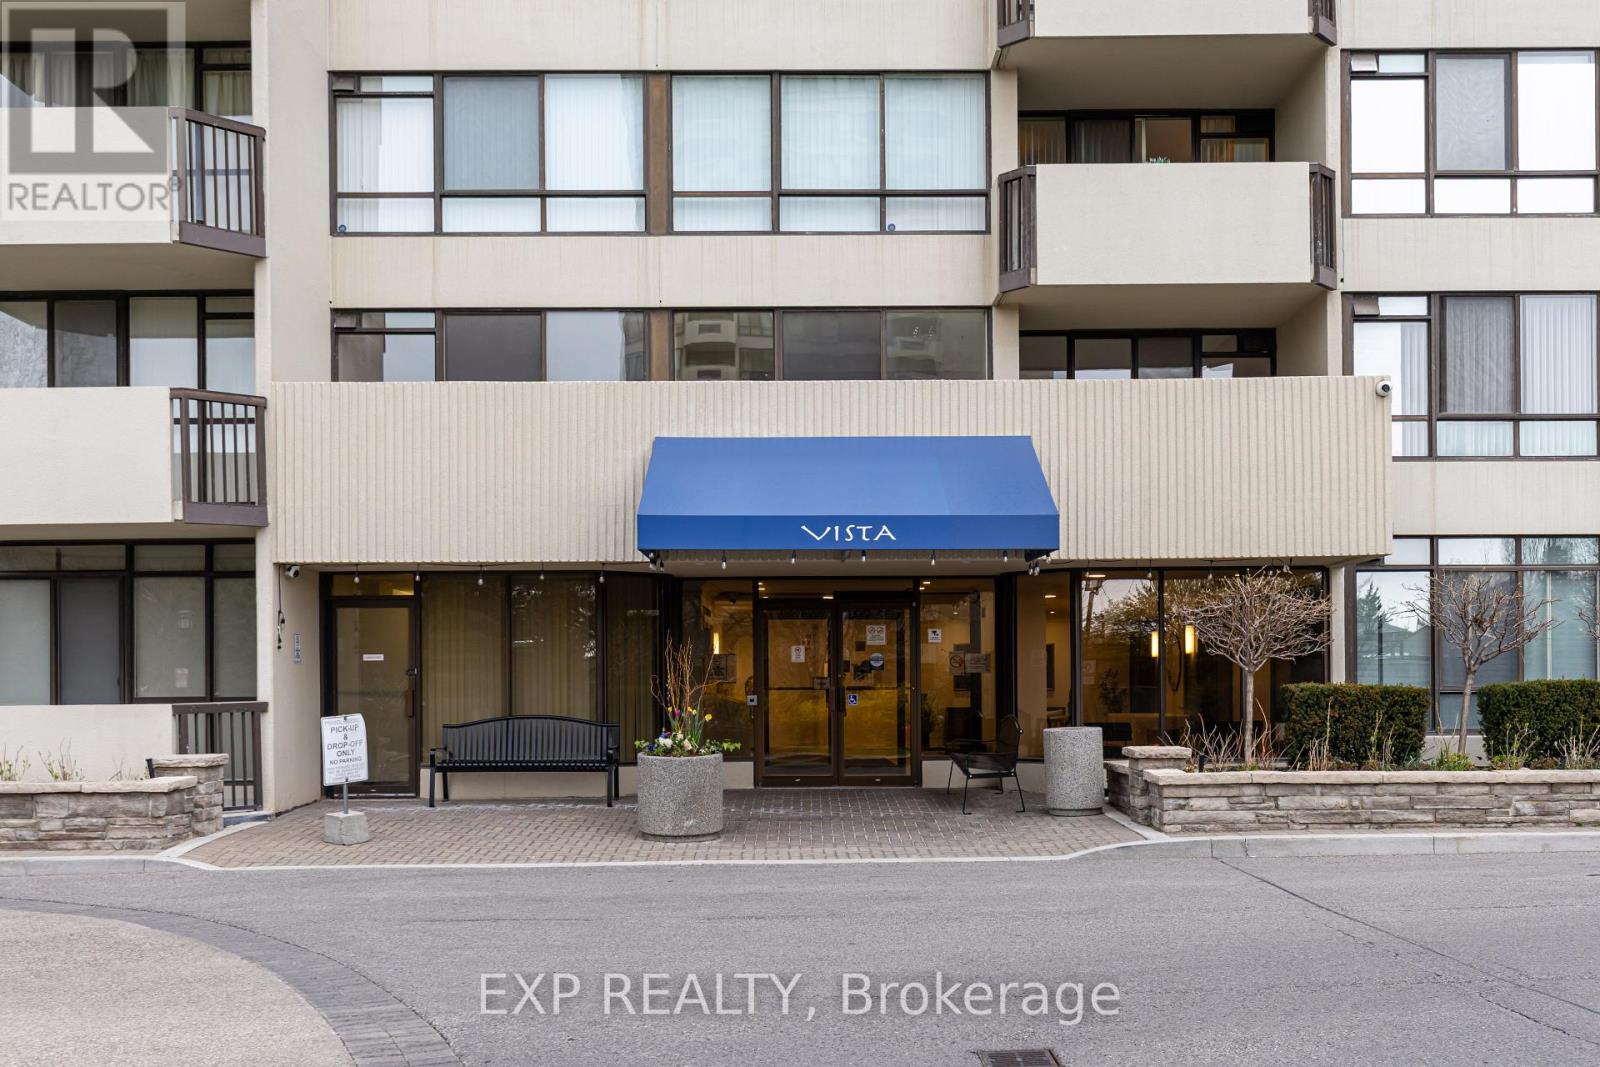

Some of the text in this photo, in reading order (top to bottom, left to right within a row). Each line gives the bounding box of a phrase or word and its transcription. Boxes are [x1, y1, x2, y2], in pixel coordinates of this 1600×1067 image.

[801, 524, 896, 541] VISTA
[331, 724, 359, 733] PICK-UP
[327, 739, 363, 750] DROP-OFF
[336, 749, 355, 757] ONLY
